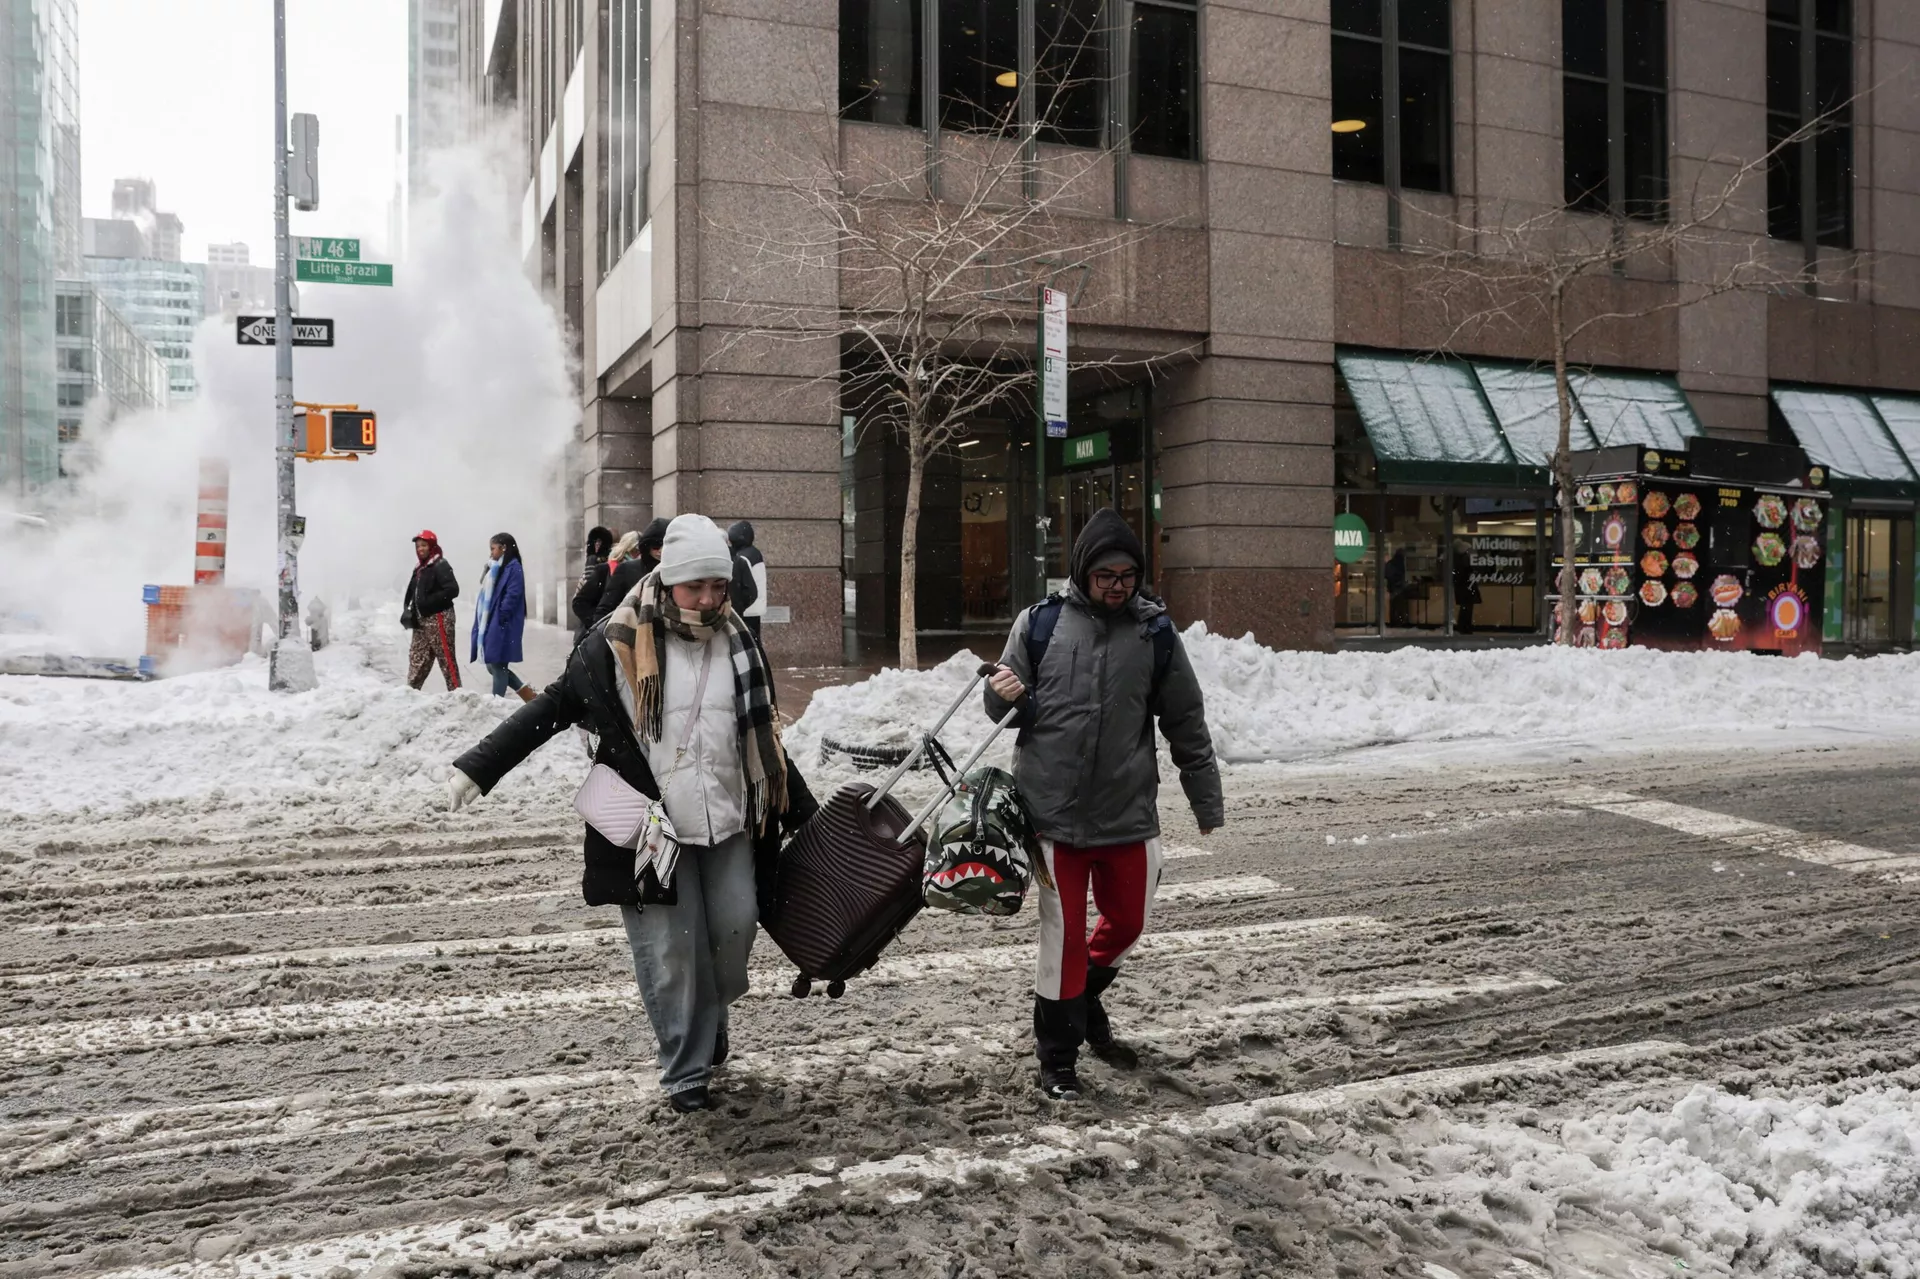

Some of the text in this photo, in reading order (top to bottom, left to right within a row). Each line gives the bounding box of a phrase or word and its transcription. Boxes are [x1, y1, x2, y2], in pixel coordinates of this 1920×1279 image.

[311, 239, 358, 258] W 46 St
[310, 261, 378, 277] Little Brazil
[296, 326, 323, 338] WAY
[361, 418, 375, 446] 8
[1076, 439, 1094, 459] NAYA
[1334, 529, 1364, 546] NAYA
[1472, 537, 1521, 550] Middle
[1469, 553, 1523, 567] Eastern
[1467, 570, 1525, 590] goodness
[1767, 582, 1809, 602] BIRYANI
